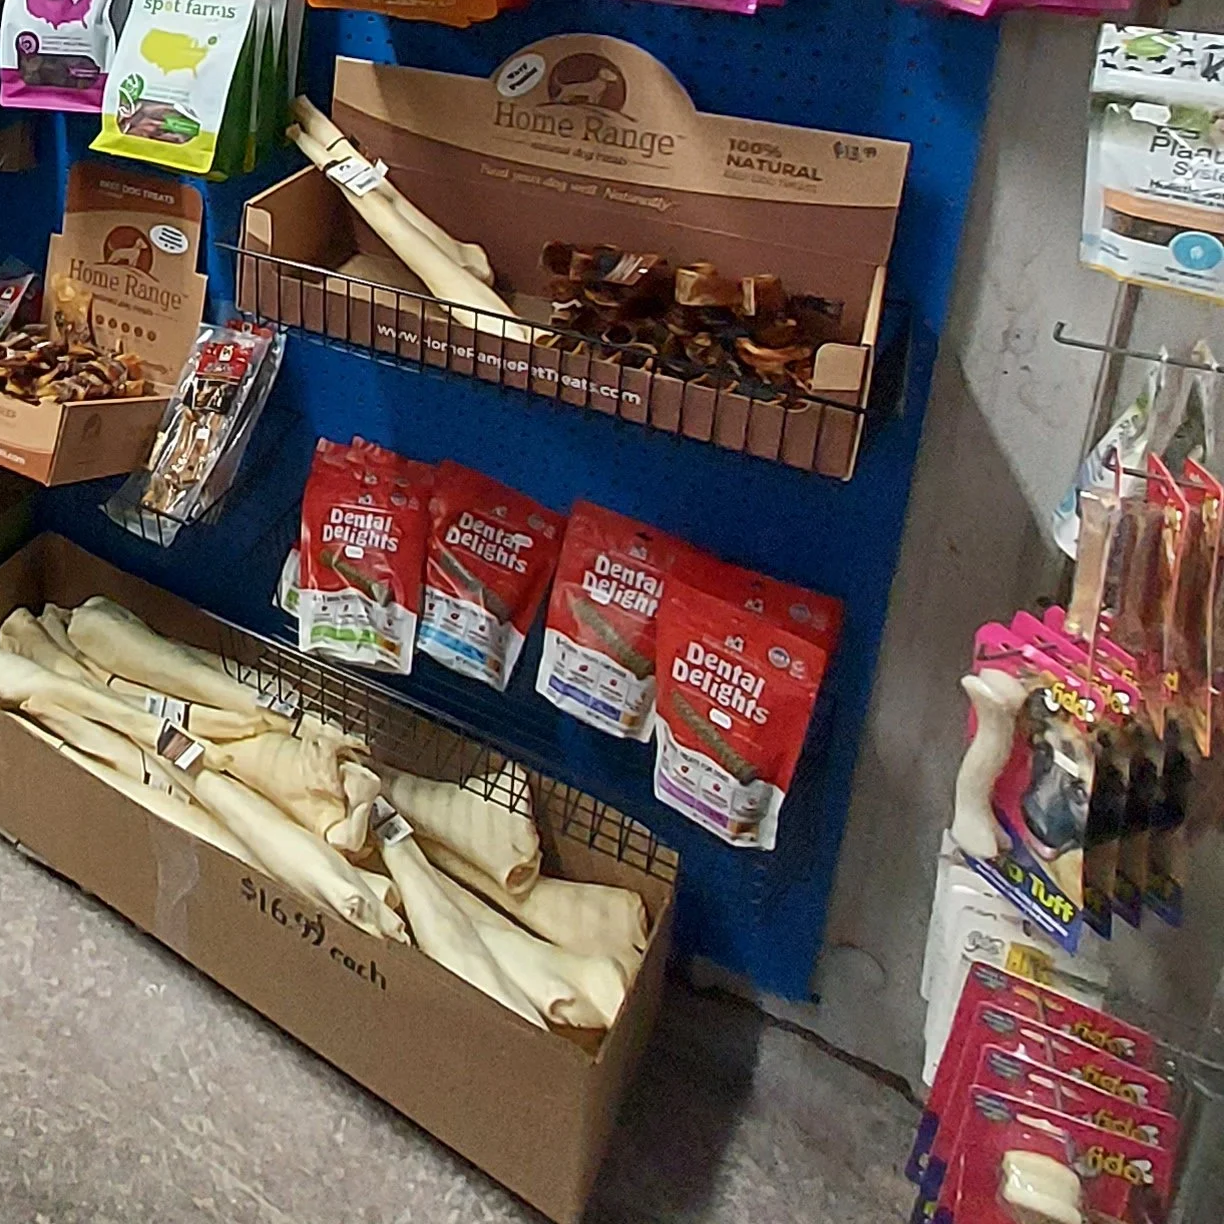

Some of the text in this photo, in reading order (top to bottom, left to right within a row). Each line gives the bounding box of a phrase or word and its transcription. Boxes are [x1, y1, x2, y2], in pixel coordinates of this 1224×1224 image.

[493, 100, 675, 158] Home Range
[728, 138, 782, 158] 100%
[726, 154, 824, 182] NATURAL
[143, 189, 175, 205] TREATS
[69, 258, 119, 292] Home
[125, 275, 182, 312] Range
[323, 524, 399, 553] Delights
[330, 508, 393, 533] Dental
[445, 527, 528, 574] Delights
[594, 553, 665, 597] Dental
[671, 657, 770, 726] Delights
[687, 641, 766, 700] Dental
[1030, 874, 1074, 923] Tuff
[330, 946, 387, 991] each
[1087, 1145, 1144, 1186] fido
